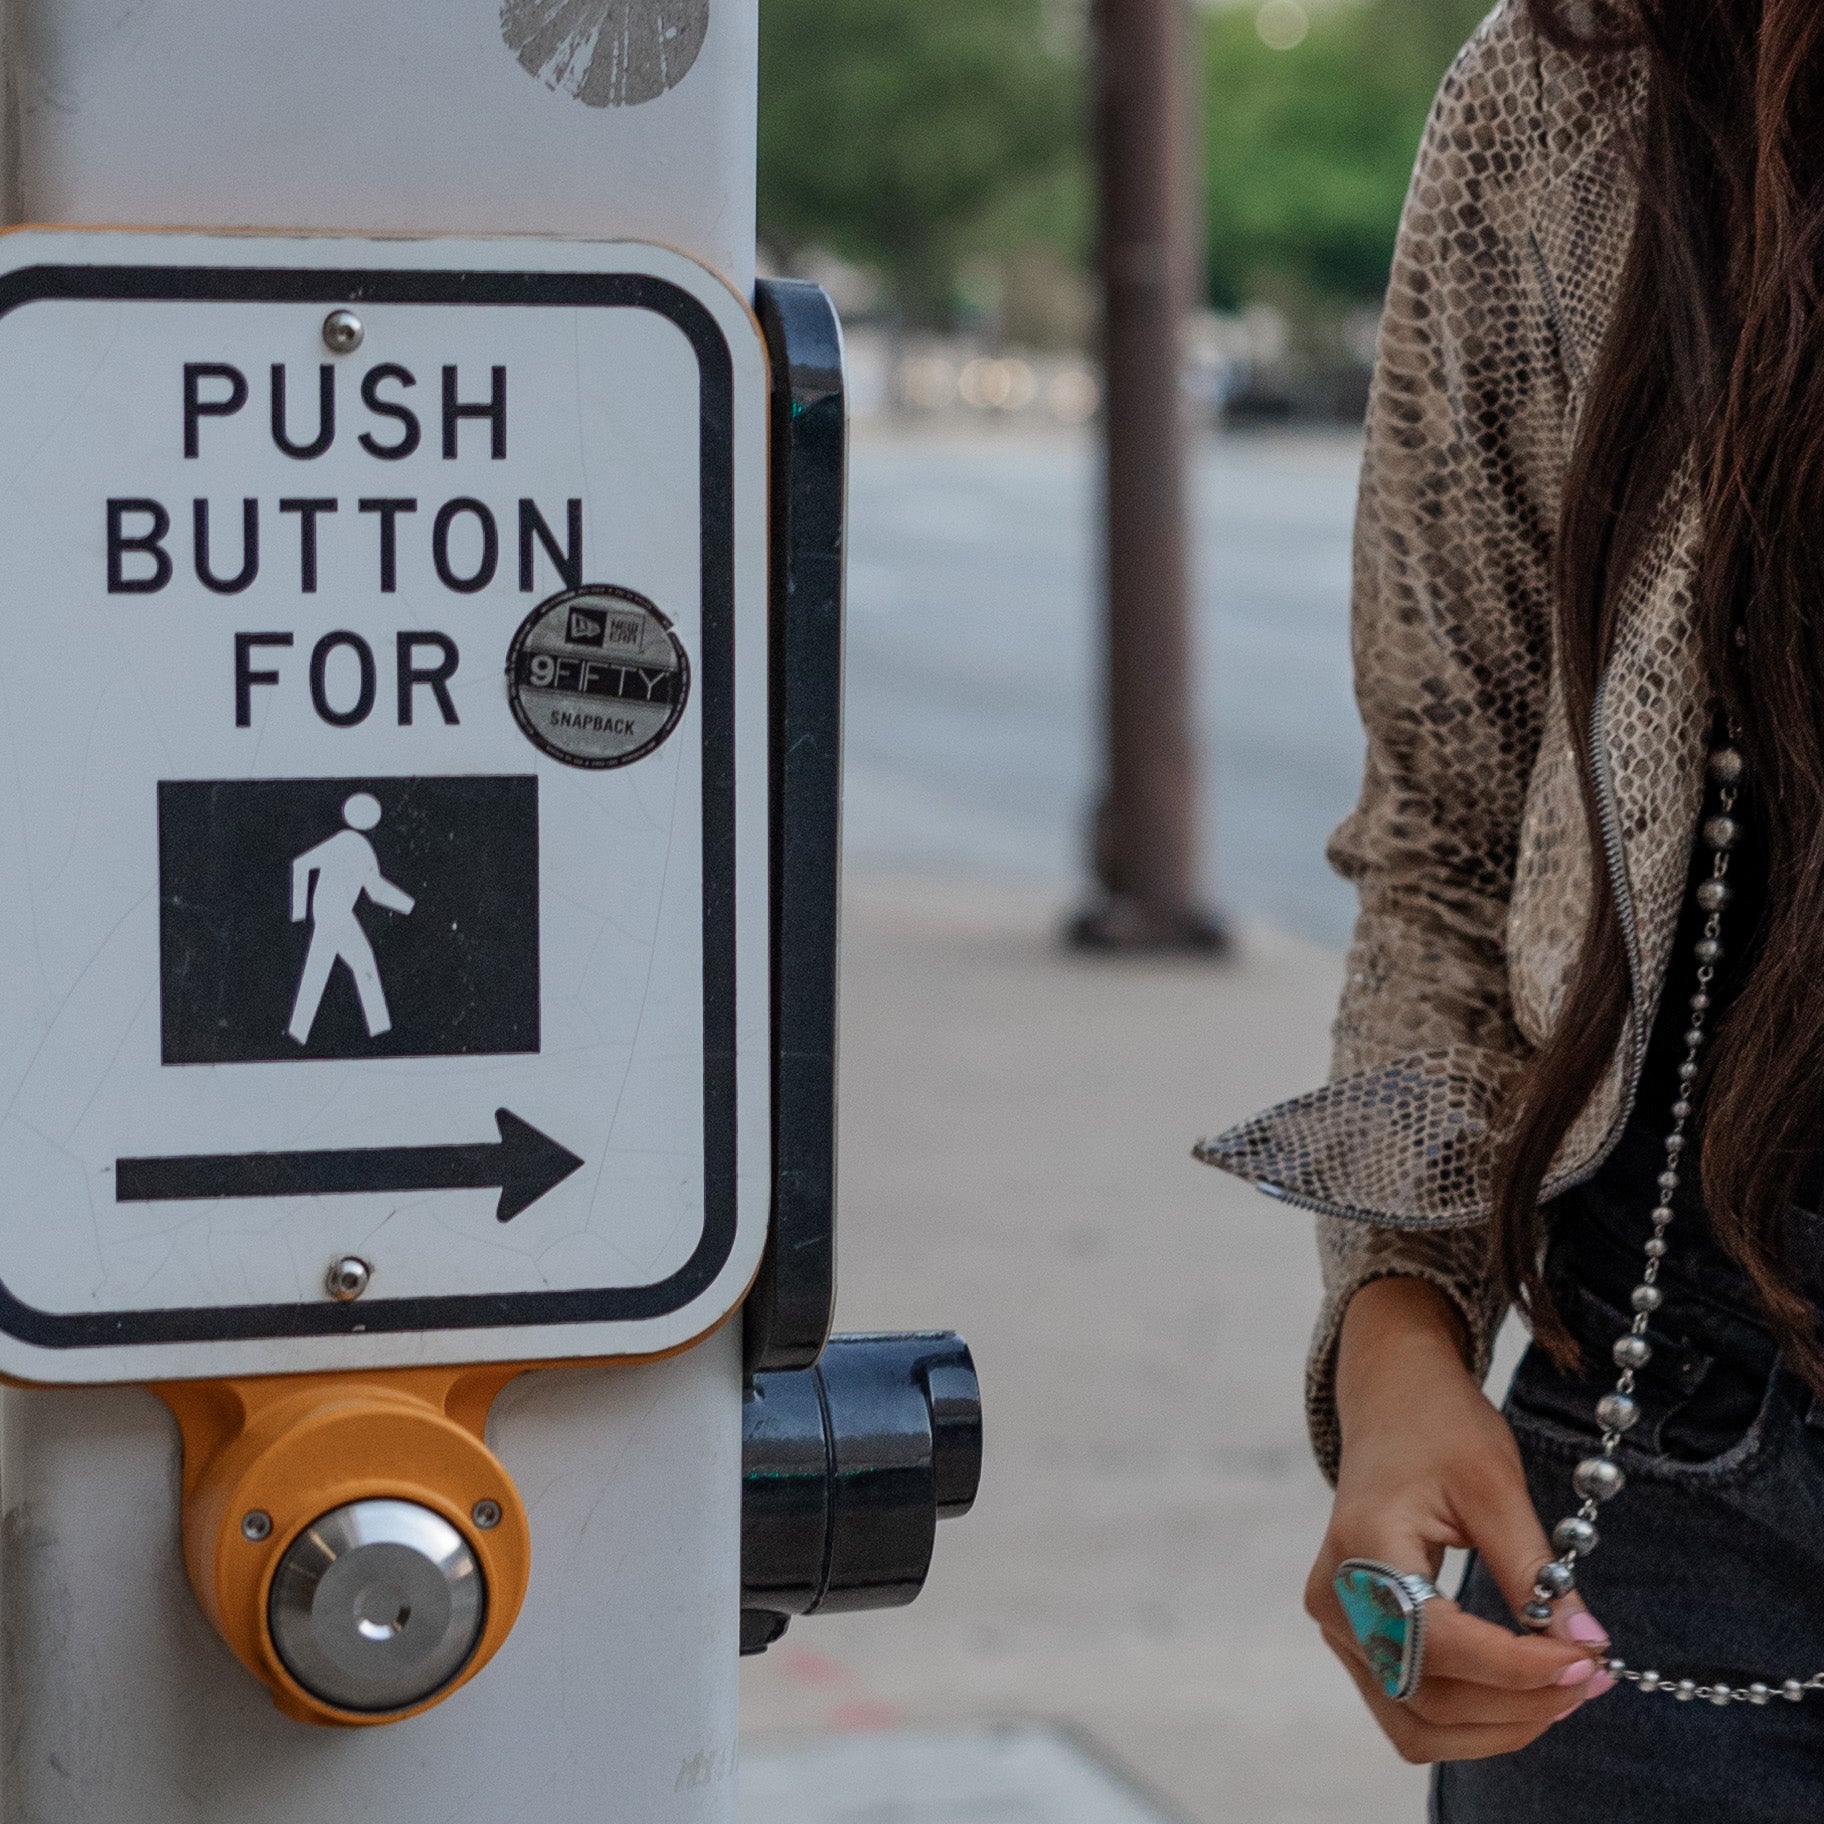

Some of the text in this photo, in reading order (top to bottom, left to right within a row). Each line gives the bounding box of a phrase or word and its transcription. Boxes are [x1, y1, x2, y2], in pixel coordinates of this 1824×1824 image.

[182, 362, 507, 459] PUSH
[106, 497, 582, 594] BUTTON
[610, 618, 639, 632] NEW
[234, 631, 461, 727] FOR
[528, 654, 670, 700] 9FIFTY
[549, 710, 635, 736] SNAPBACK
